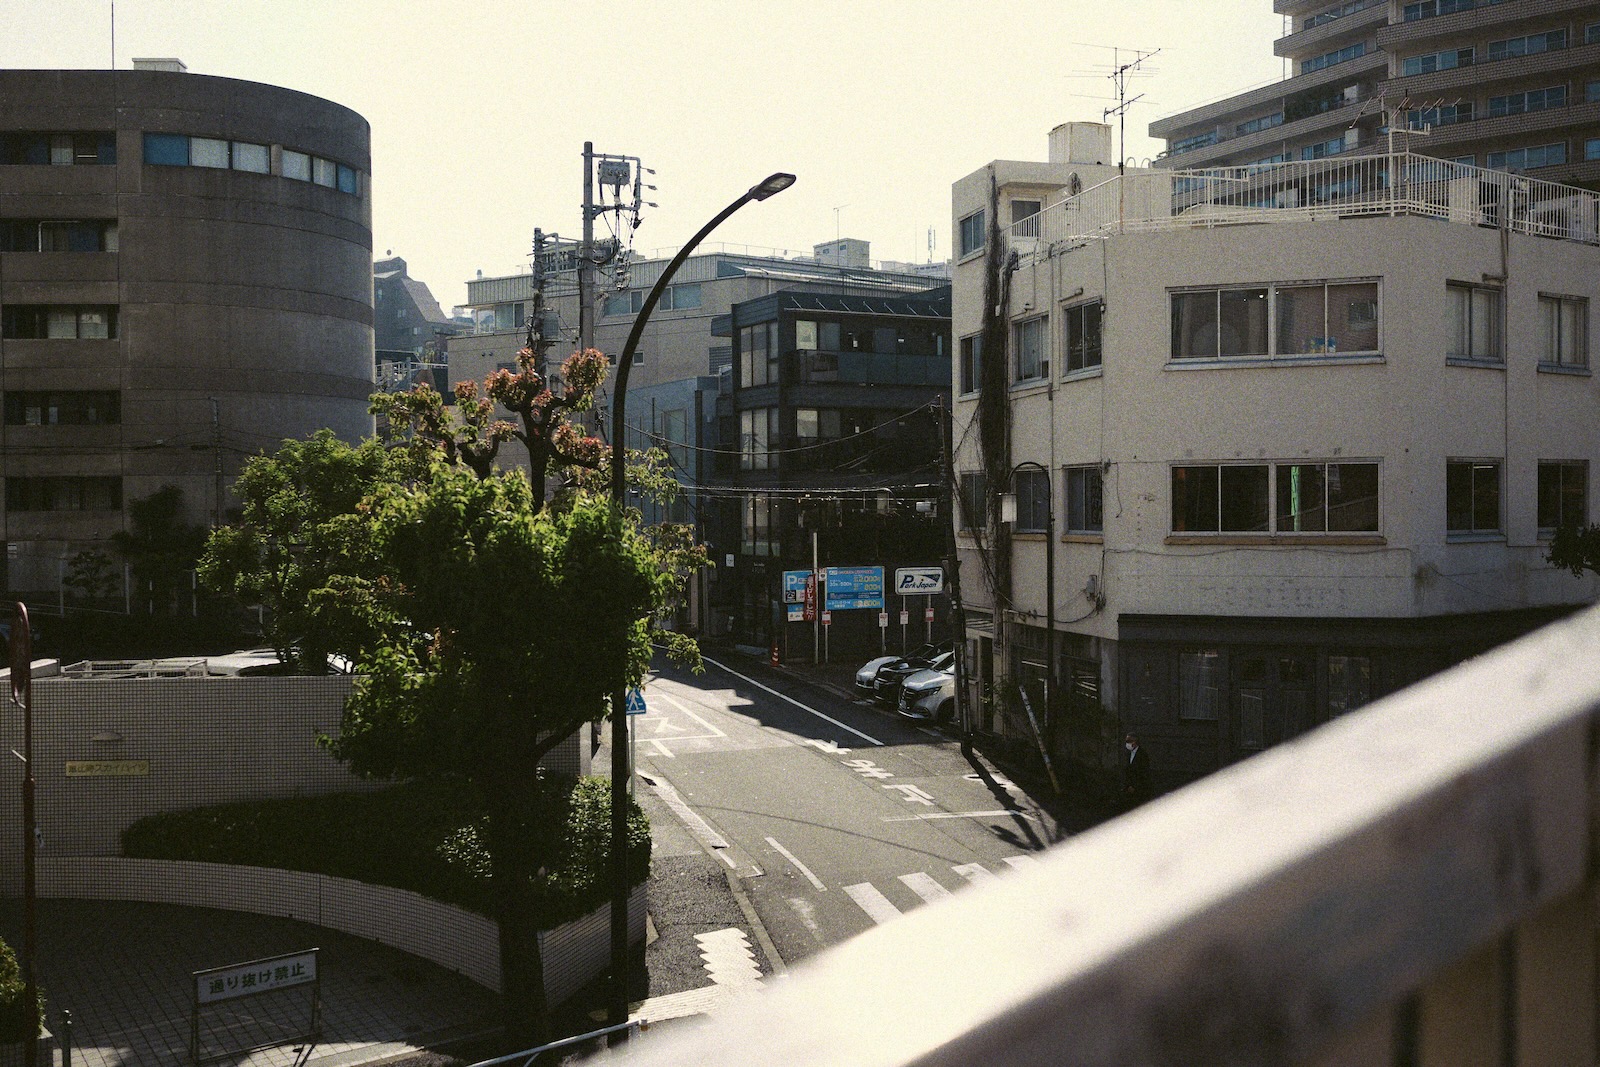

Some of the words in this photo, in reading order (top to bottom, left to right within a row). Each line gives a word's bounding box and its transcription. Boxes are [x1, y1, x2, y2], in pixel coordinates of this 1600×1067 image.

[787, 575, 797, 590] P
[209, 963, 306, 994] 通り抜け禁止
